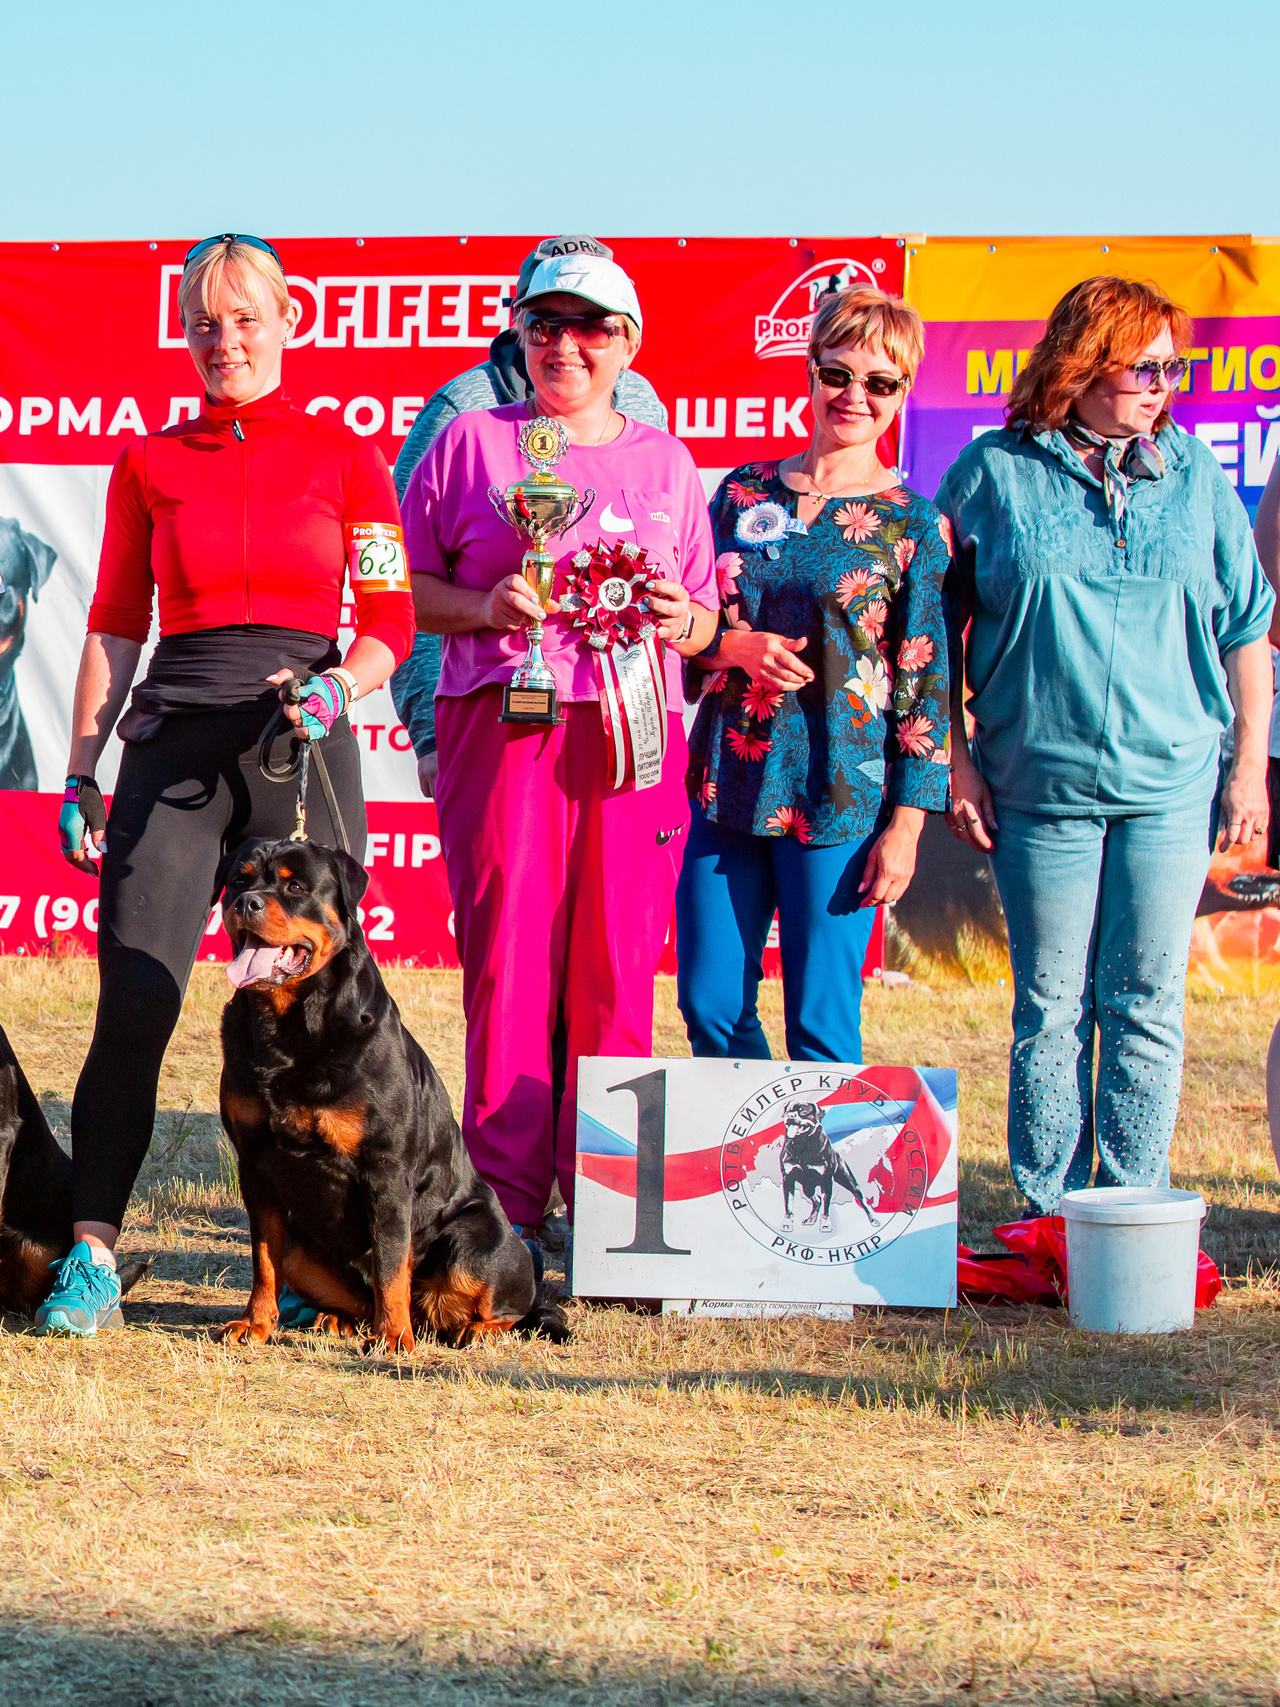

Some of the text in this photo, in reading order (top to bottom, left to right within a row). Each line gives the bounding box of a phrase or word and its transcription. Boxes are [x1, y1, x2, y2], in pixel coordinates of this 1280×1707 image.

[675, 396, 810, 438] ШЕК
[537, 435, 549, 451] 1
[359, 540, 397, 576] 62
[34, 895, 98, 938] (90
[606, 1069, 692, 1255] 1
[724, 1075, 925, 1217] РОТВЕЙЛЕР КЛУБ РОССИИ
[771, 1235, 882, 1263] РКФ-НКПР
